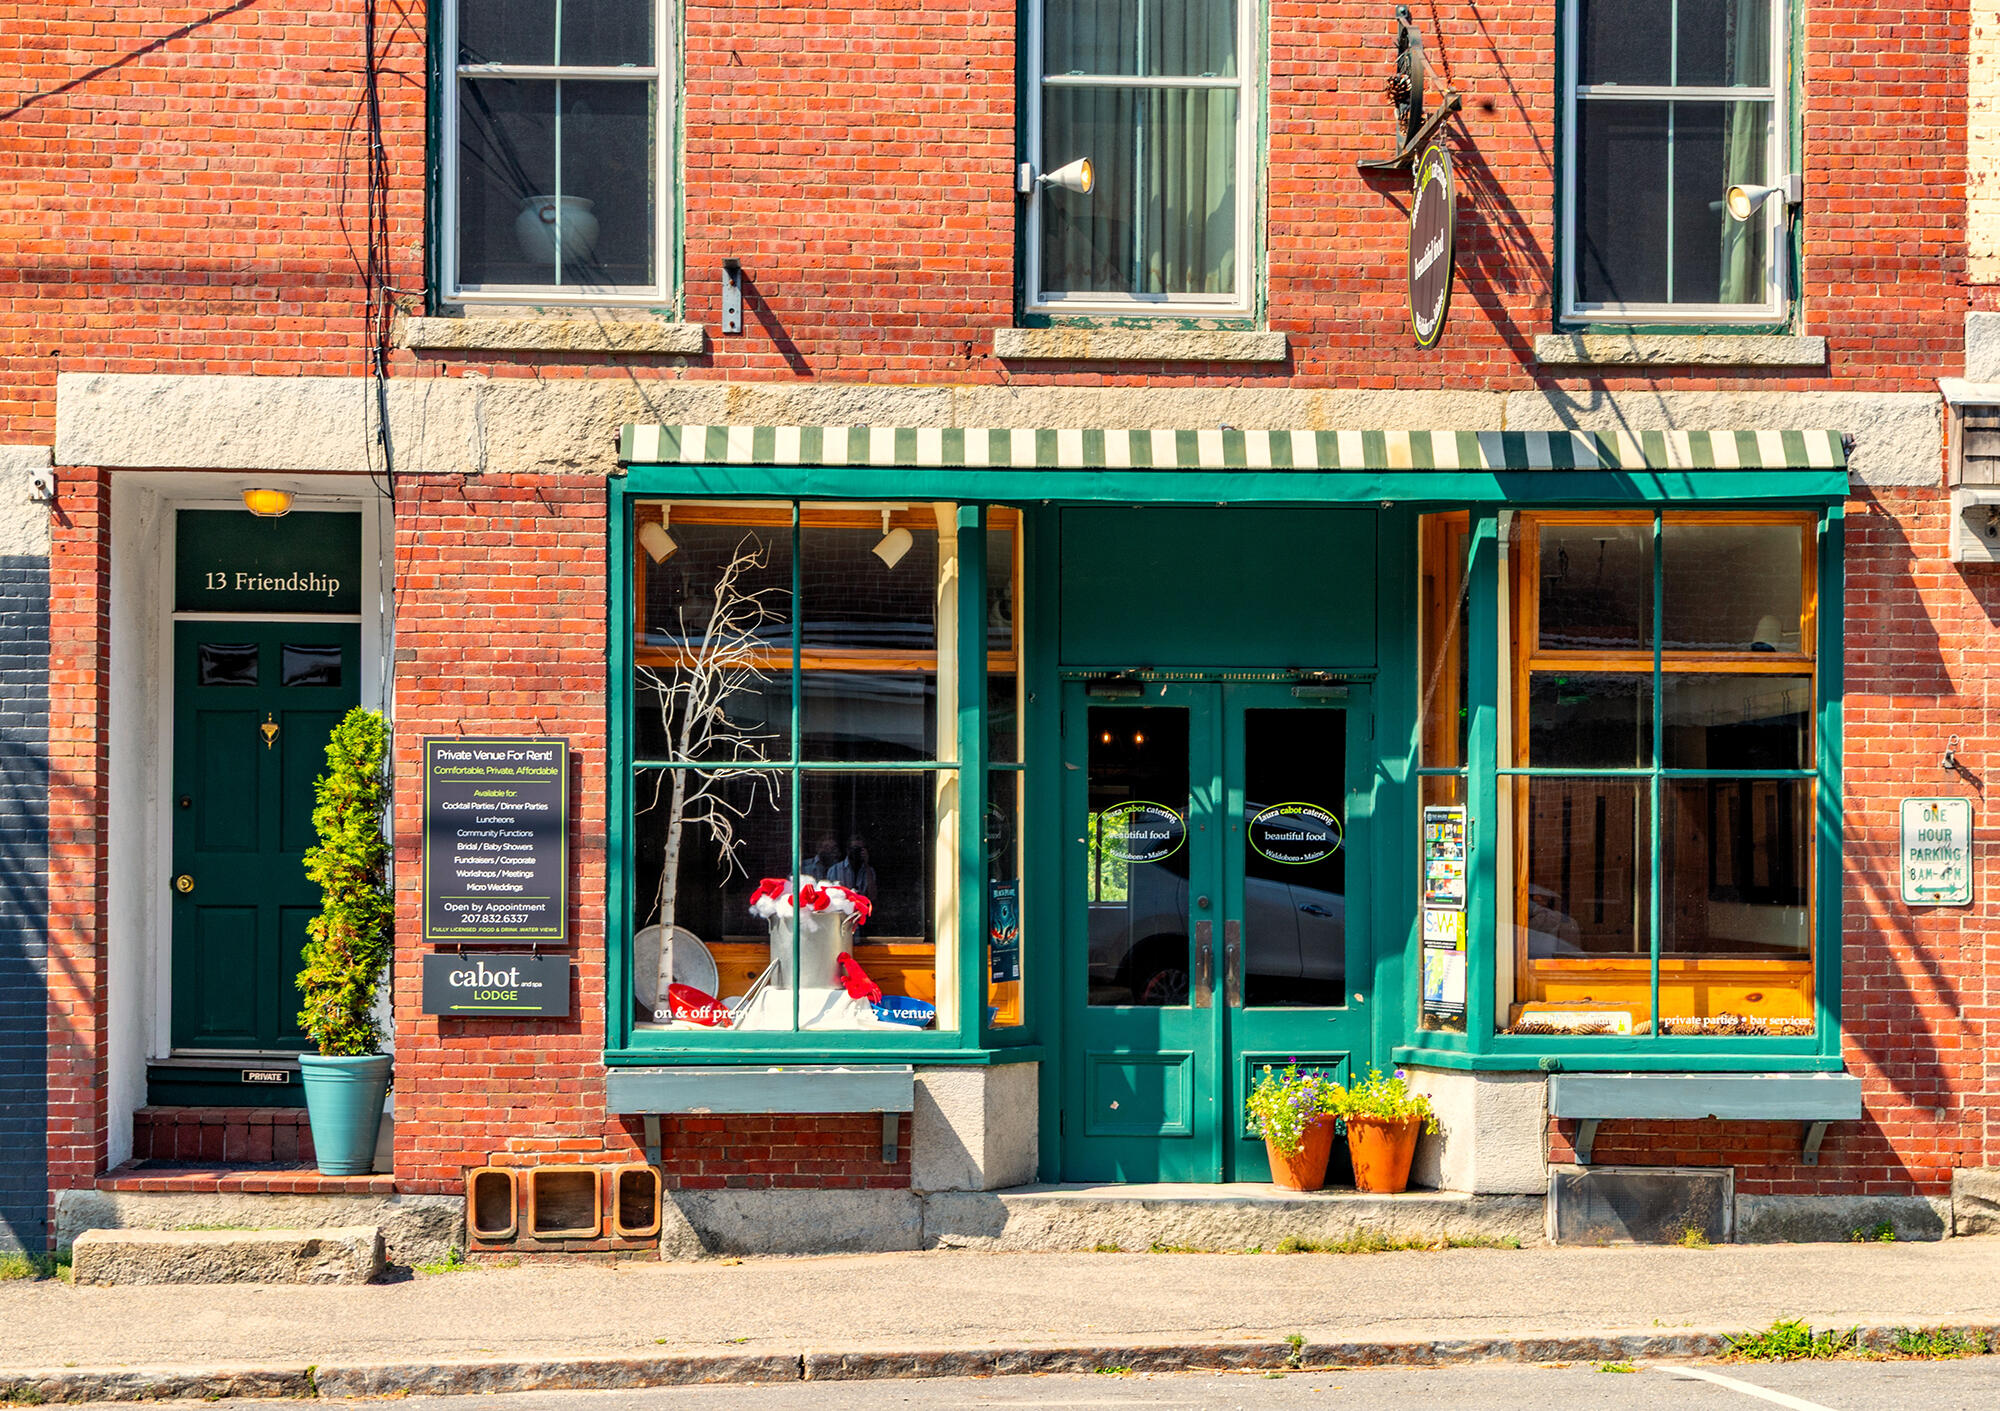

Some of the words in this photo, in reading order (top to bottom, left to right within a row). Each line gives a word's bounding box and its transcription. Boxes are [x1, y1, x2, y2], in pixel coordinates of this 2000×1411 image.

[205, 572, 227, 590] 13
[235, 571, 340, 597] Friendship
[437, 750, 471, 761] Private
[473, 750, 505, 761] Venue
[507, 750, 525, 761] For
[526, 751, 553, 761] Rent!
[433, 766, 486, 776] Comfortable,
[486, 767, 515, 776] Private,
[516, 767, 559, 776] Affordable
[473, 790, 505, 798] Available
[442, 802, 470, 811] Cocktail
[471, 802, 495, 811] Parties
[500, 802, 523, 811] Dinner
[524, 802, 549, 811] Parties
[1123, 804, 1146, 814] cabot
[1146, 807, 1178, 825] catering
[1258, 809, 1280, 823] laura
[1279, 806, 1302, 815] cabot
[1302, 808, 1334, 826] catering
[1923, 809, 1947, 822] ONE
[475, 816, 515, 824] Luncheons
[456, 829, 499, 838] Community
[499, 830, 534, 838] Functions
[1149, 830, 1170, 839] food
[1264, 831, 1304, 841] beautiful
[1305, 832, 1326, 841] food
[1918, 829, 1952, 842] HOUR
[457, 842, 477, 851] Bridal
[483, 843, 503, 852] Baby
[502, 843, 534, 851] Showers
[1147, 849, 1168, 859] Maine
[1265, 849, 1300, 861] Waldoboro
[1303, 850, 1324, 861] Maine
[1910, 848, 1961, 861] PARKING
[454, 856, 495, 864] Fundraisers
[500, 857, 537, 865] Corporate
[456, 870, 497, 878] Workshops
[502, 870, 534, 879] Meetings
[466, 883, 487, 891] Micro
[487, 884, 524, 892] Weddings
[444, 903, 470, 912] Open
[471, 903, 483, 912] by
[485, 903, 546, 912] Appointment
[461, 914, 529, 923] 207.832.6337
[449, 961, 520, 988] cabot
[474, 990, 518, 1000] LODGE
[654, 1009, 672, 1019] on
[675, 1006, 688, 1018] &
[690, 1005, 711, 1018] off
[892, 1009, 935, 1019] venue
[1665, 1015, 1701, 1027] private
[1703, 1015, 1739, 1027] parties
[1750, 1014, 1767, 1025] bar
[1769, 1016, 1811, 1026] services
[248, 1072, 282, 1081] PRIVATE
